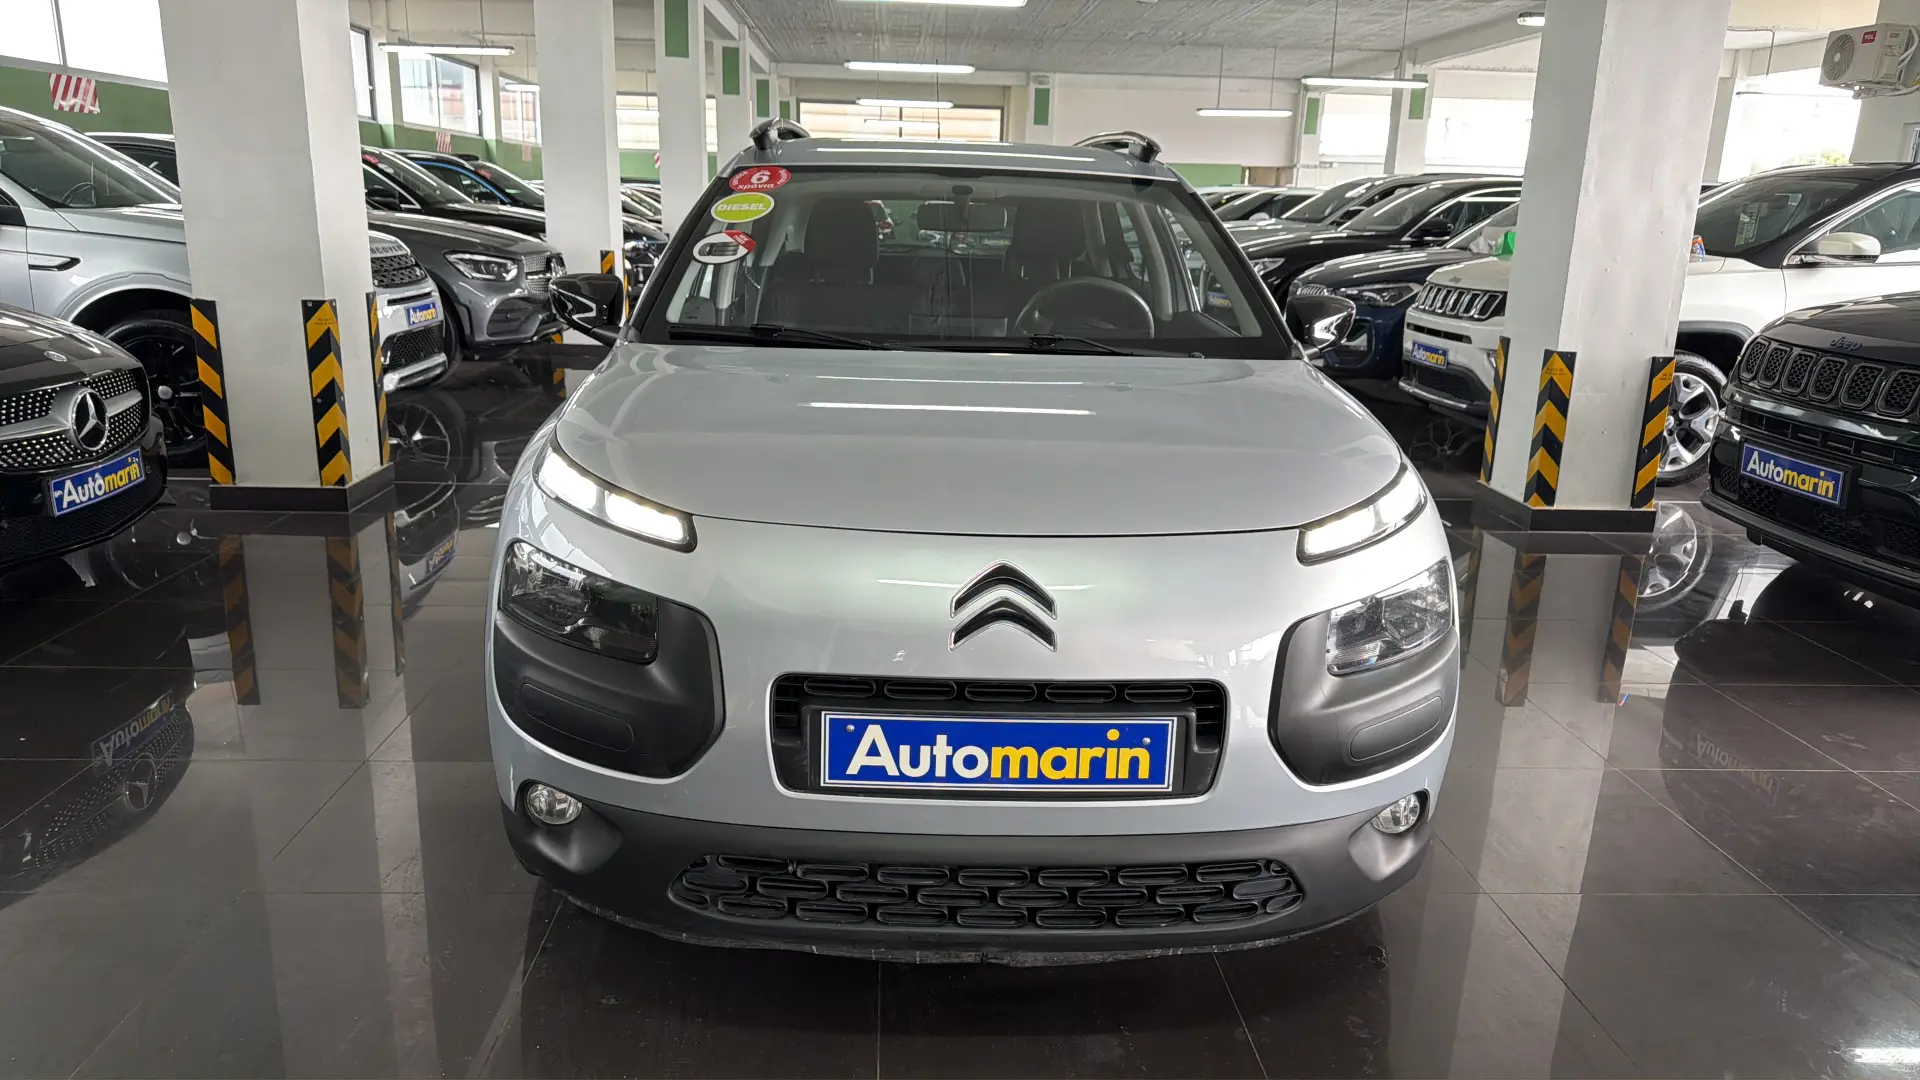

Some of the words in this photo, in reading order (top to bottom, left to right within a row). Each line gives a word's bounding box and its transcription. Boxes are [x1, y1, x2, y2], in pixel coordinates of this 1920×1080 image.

[751, 171, 771, 184] 6
[717, 203, 767, 211] DIESEL
[1829, 336, 1863, 350] Jeep
[62, 457, 140, 509] Automarin
[1746, 451, 1834, 498] Automarin
[845, 724, 1150, 779] Automarin
